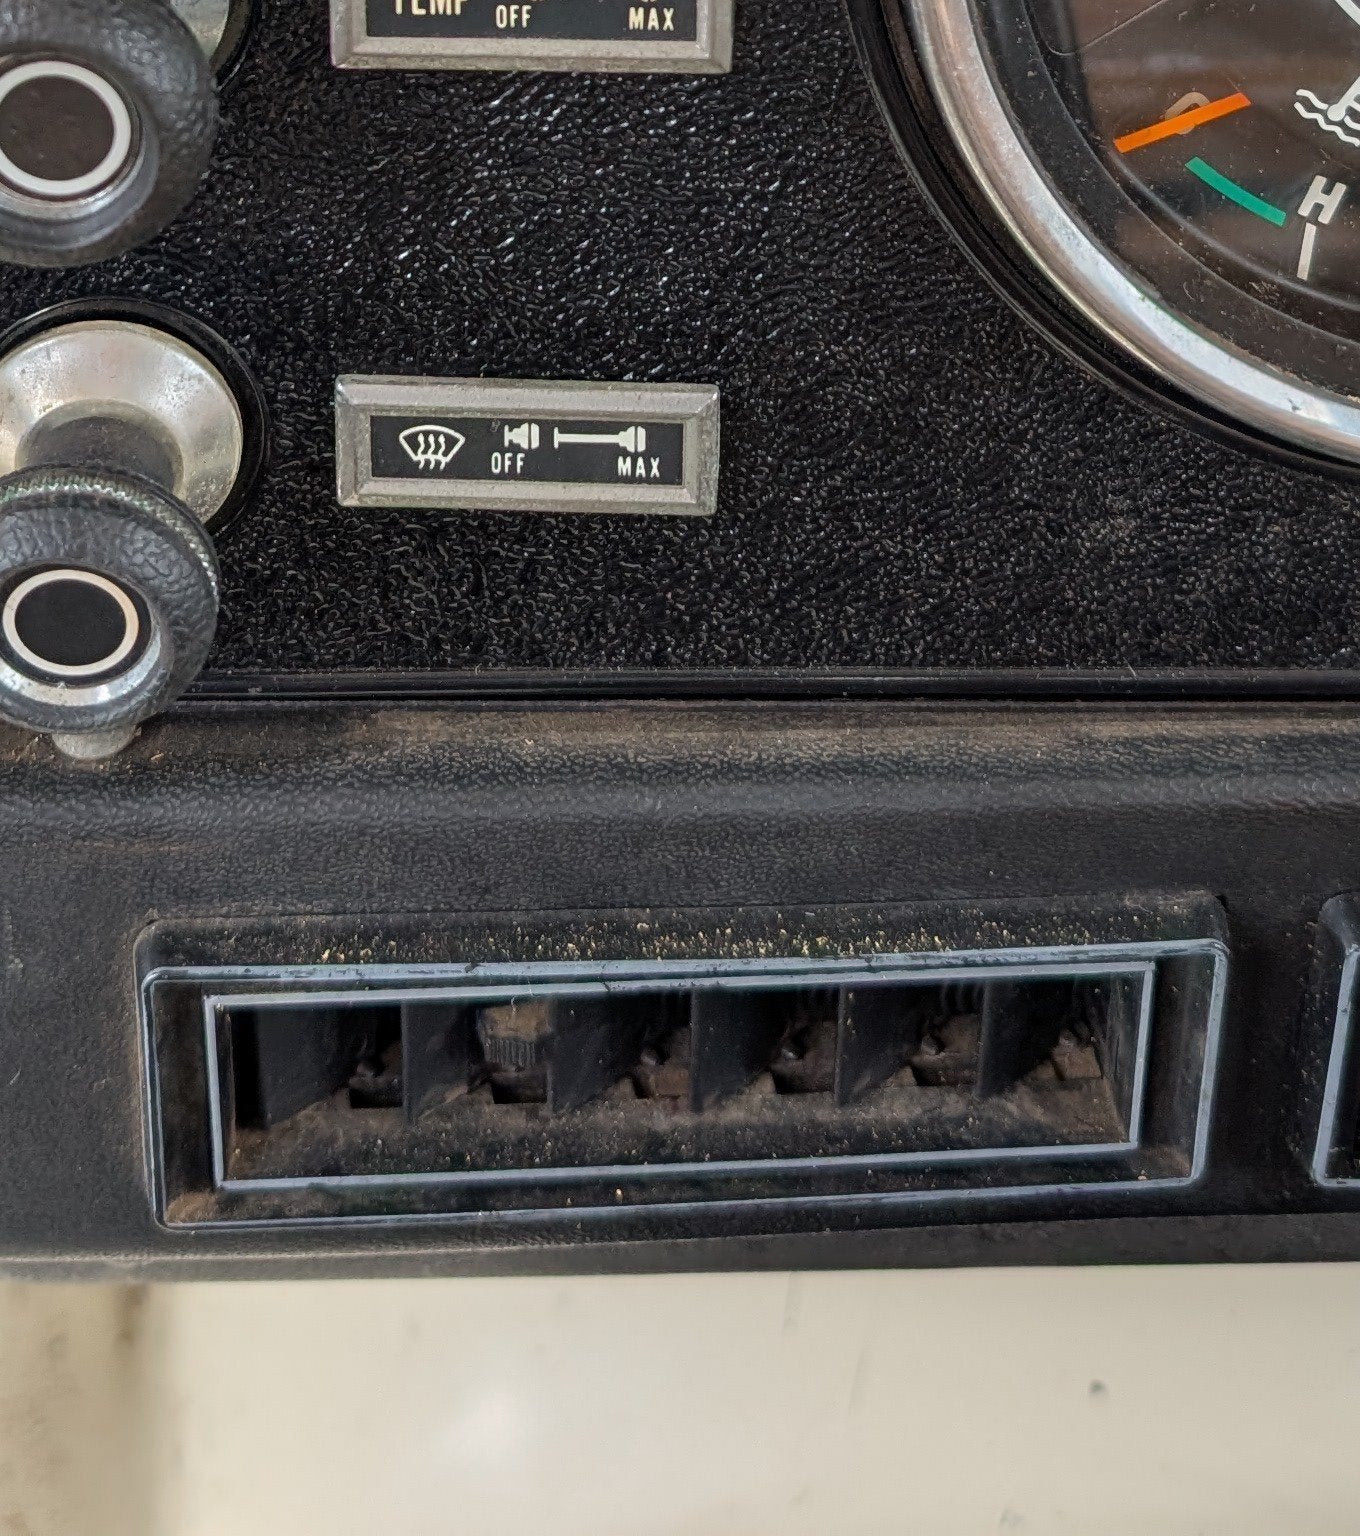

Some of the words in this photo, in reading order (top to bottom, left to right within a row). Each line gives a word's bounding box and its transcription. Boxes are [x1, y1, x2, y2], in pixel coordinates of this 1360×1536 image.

[495, 5, 531, 29] OFF
[628, 7, 675, 32] MAX
[1297, 175, 1347, 224] H
[491, 452, 526, 475] OFF
[618, 456, 660, 479] MAX
